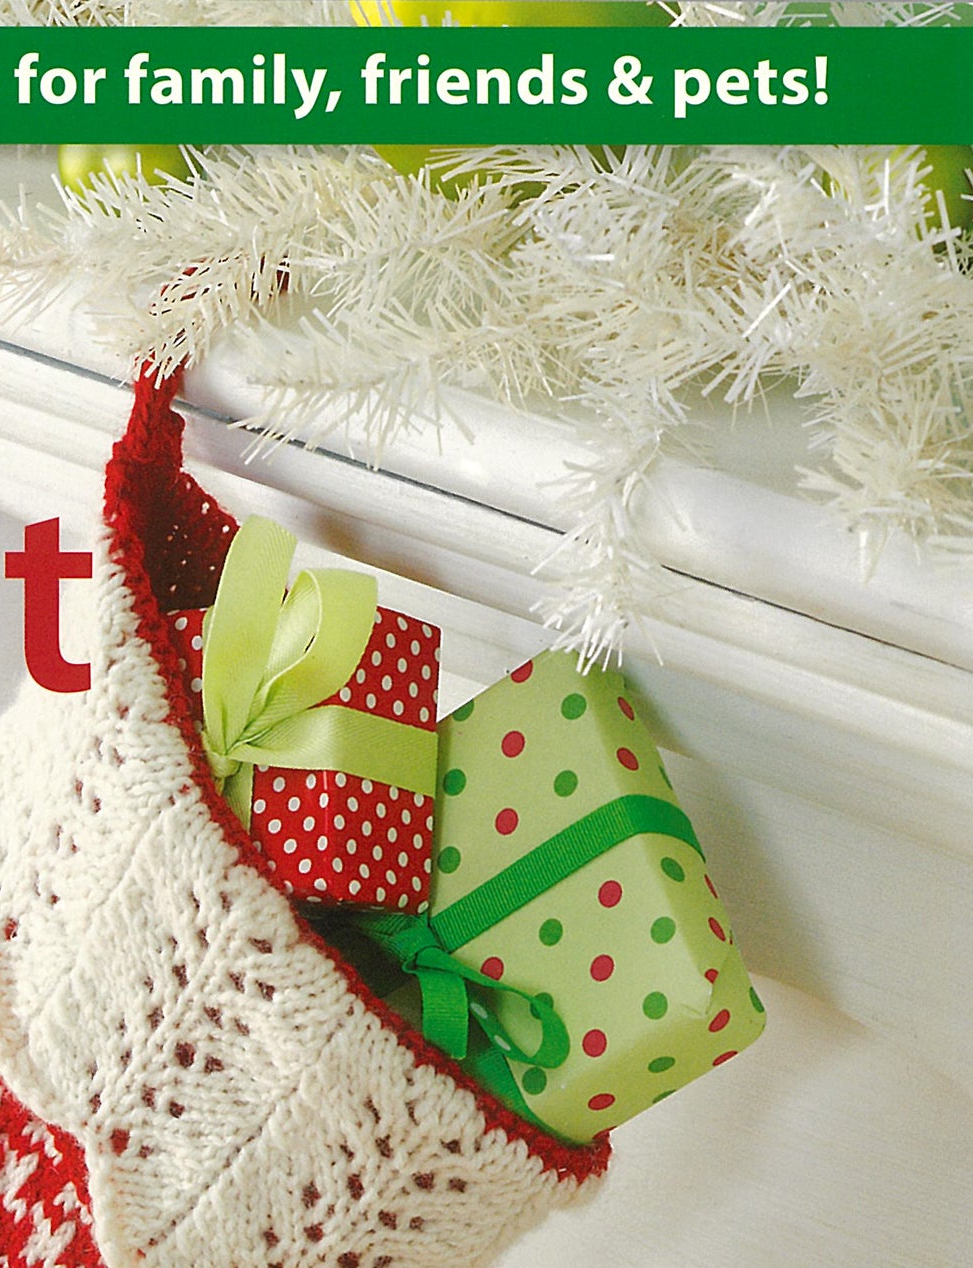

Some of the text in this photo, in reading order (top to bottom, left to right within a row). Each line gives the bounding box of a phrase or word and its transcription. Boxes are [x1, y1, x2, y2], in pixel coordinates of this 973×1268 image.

[14, 54, 105, 105] for
[125, 53, 341, 119] family,
[361, 54, 588, 105] friends
[607, 56, 653, 105] &
[674, 55, 829, 117] pets!
